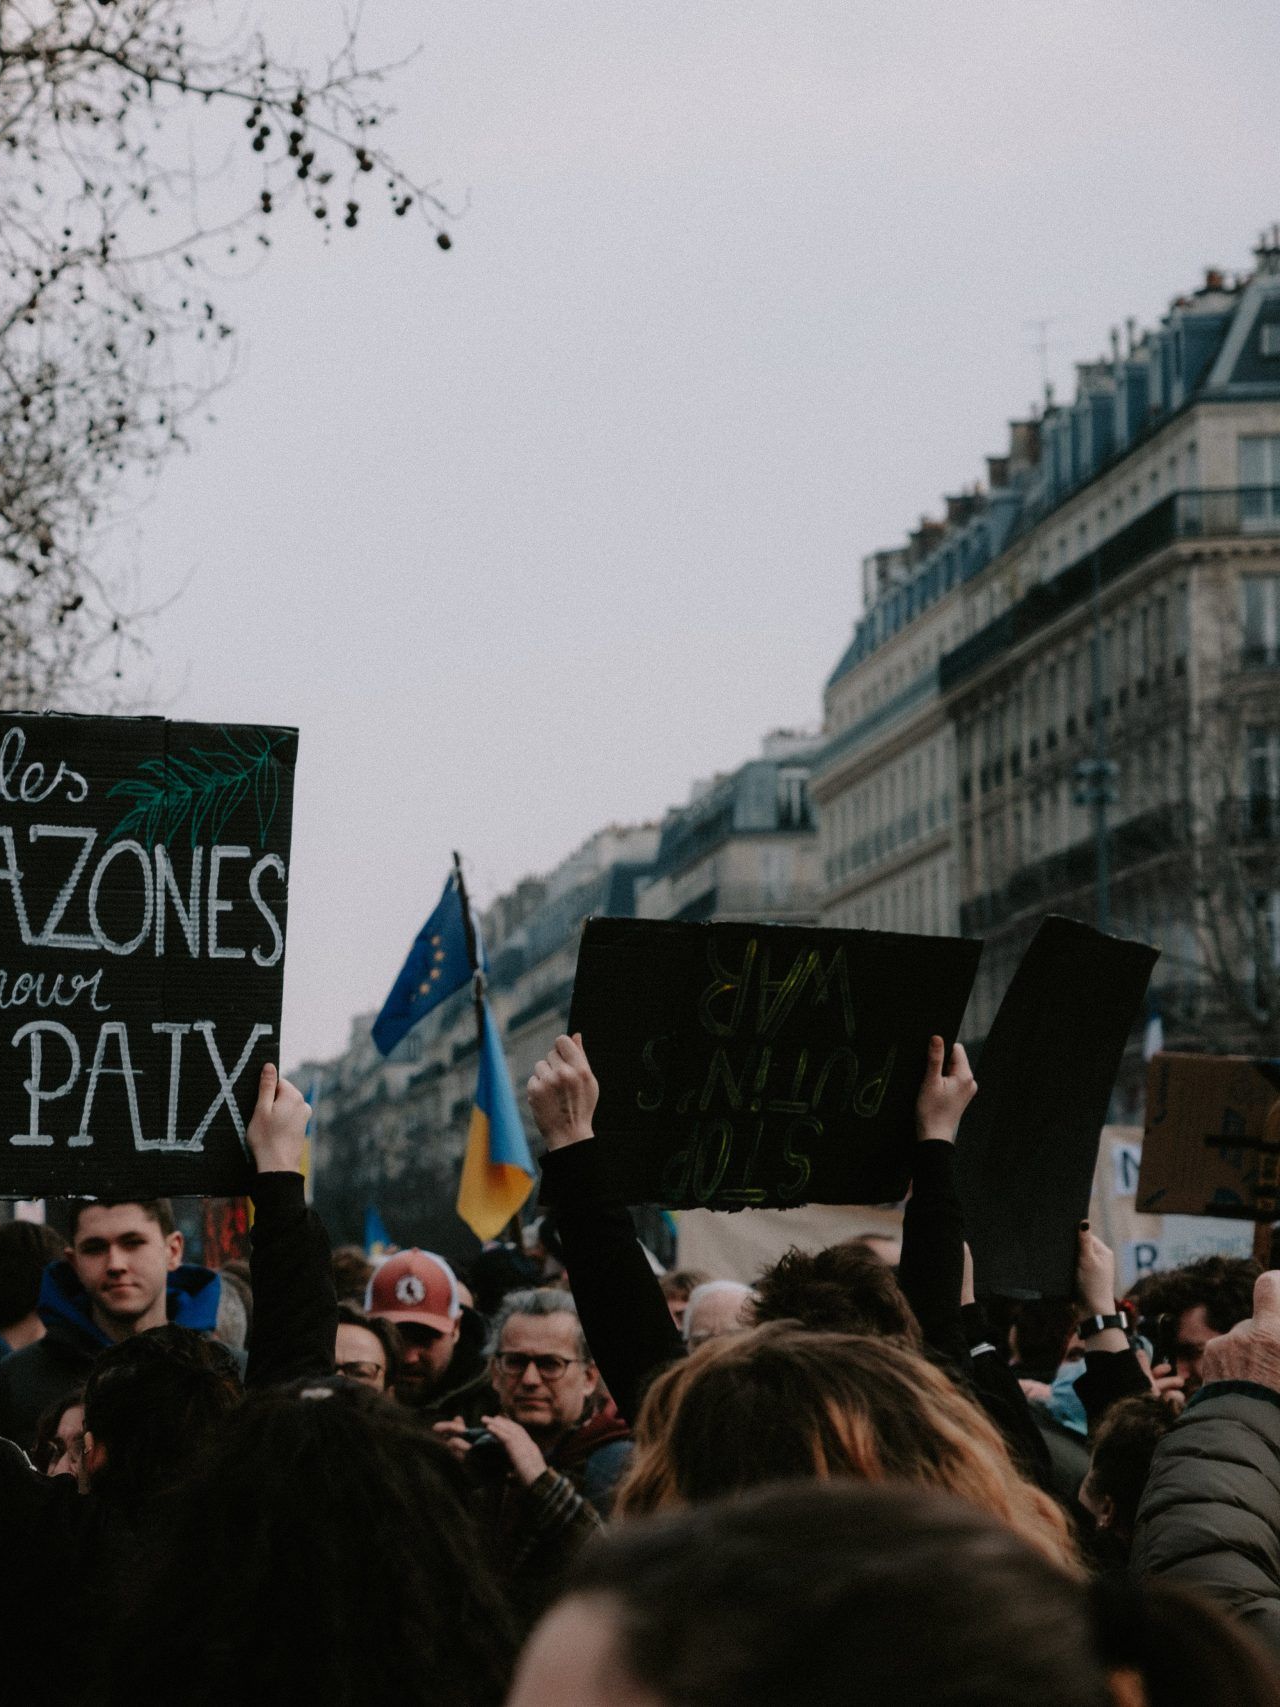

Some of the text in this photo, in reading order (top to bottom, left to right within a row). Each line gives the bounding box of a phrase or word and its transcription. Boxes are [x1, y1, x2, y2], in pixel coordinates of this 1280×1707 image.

[701, 935, 857, 1038] WAR
[10, 1020, 266, 1158] PAIX
[662, 1115, 824, 1203] STOP
